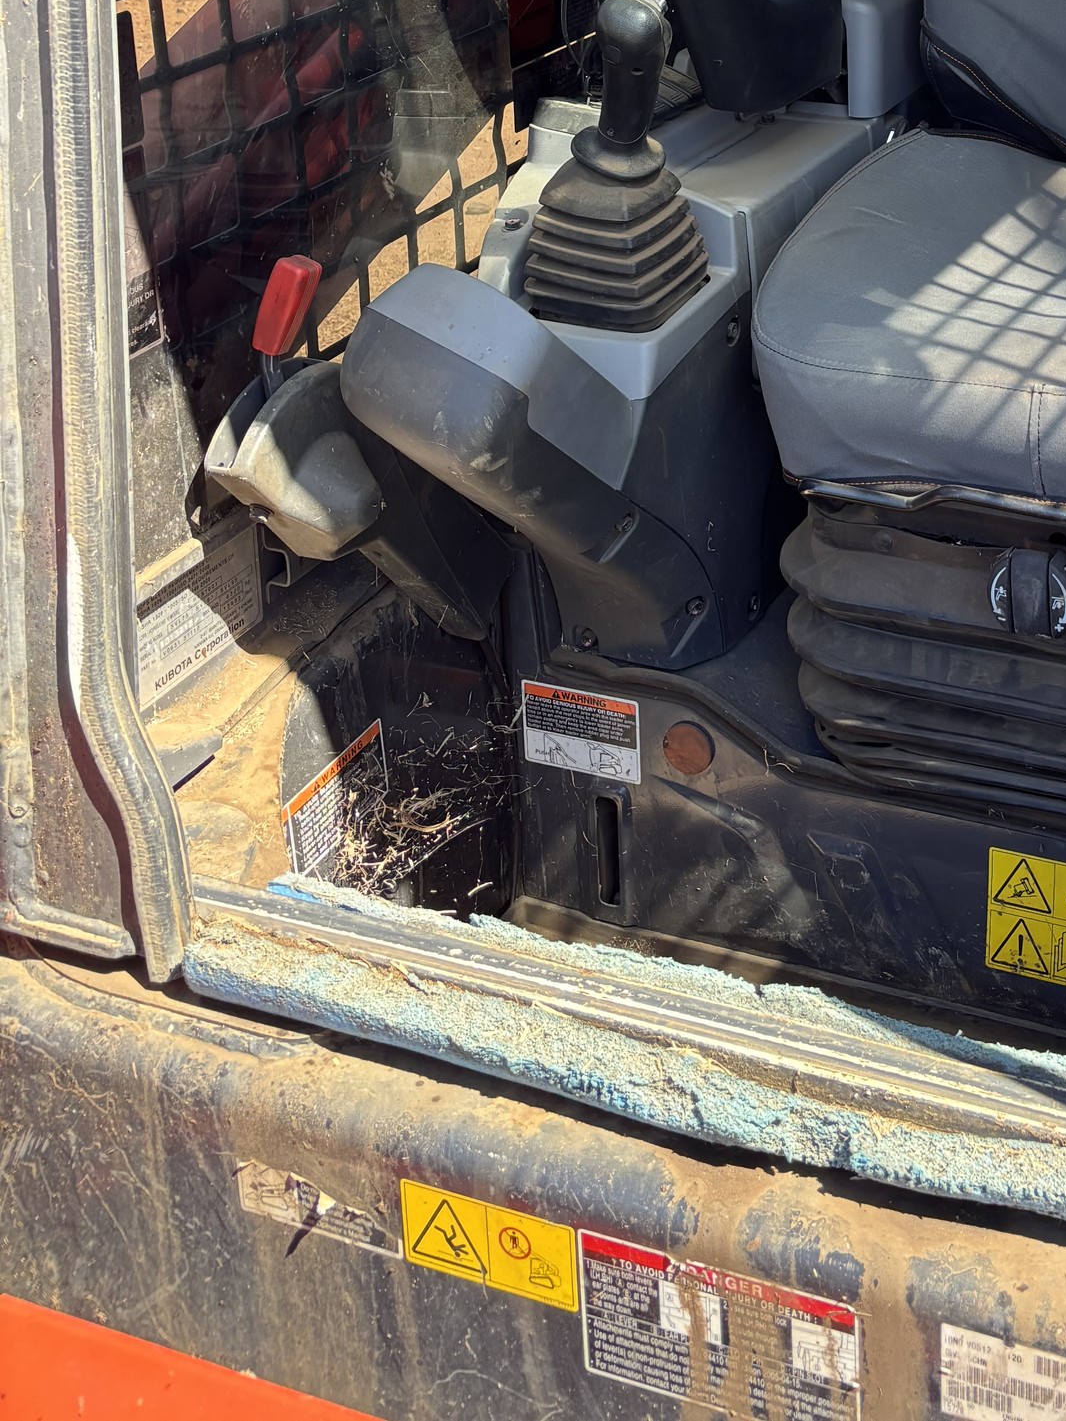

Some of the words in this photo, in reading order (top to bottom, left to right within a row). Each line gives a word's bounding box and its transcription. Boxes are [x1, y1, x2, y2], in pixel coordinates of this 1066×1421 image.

[154, 654, 192, 692] KUBOTA
[534, 696, 551, 704] AVOID
[552, 699, 576, 709] SERIOUS
[561, 691, 606, 708] WARNING
[321, 741, 364, 784] WARNING
[619, 1258, 632, 1270] TO
[636, 1263, 664, 1279] AVOID
[760, 1299, 775, 1312] OR
[687, 1265, 763, 1298] DANGER
[592, 1318, 633, 1338] Attachments
